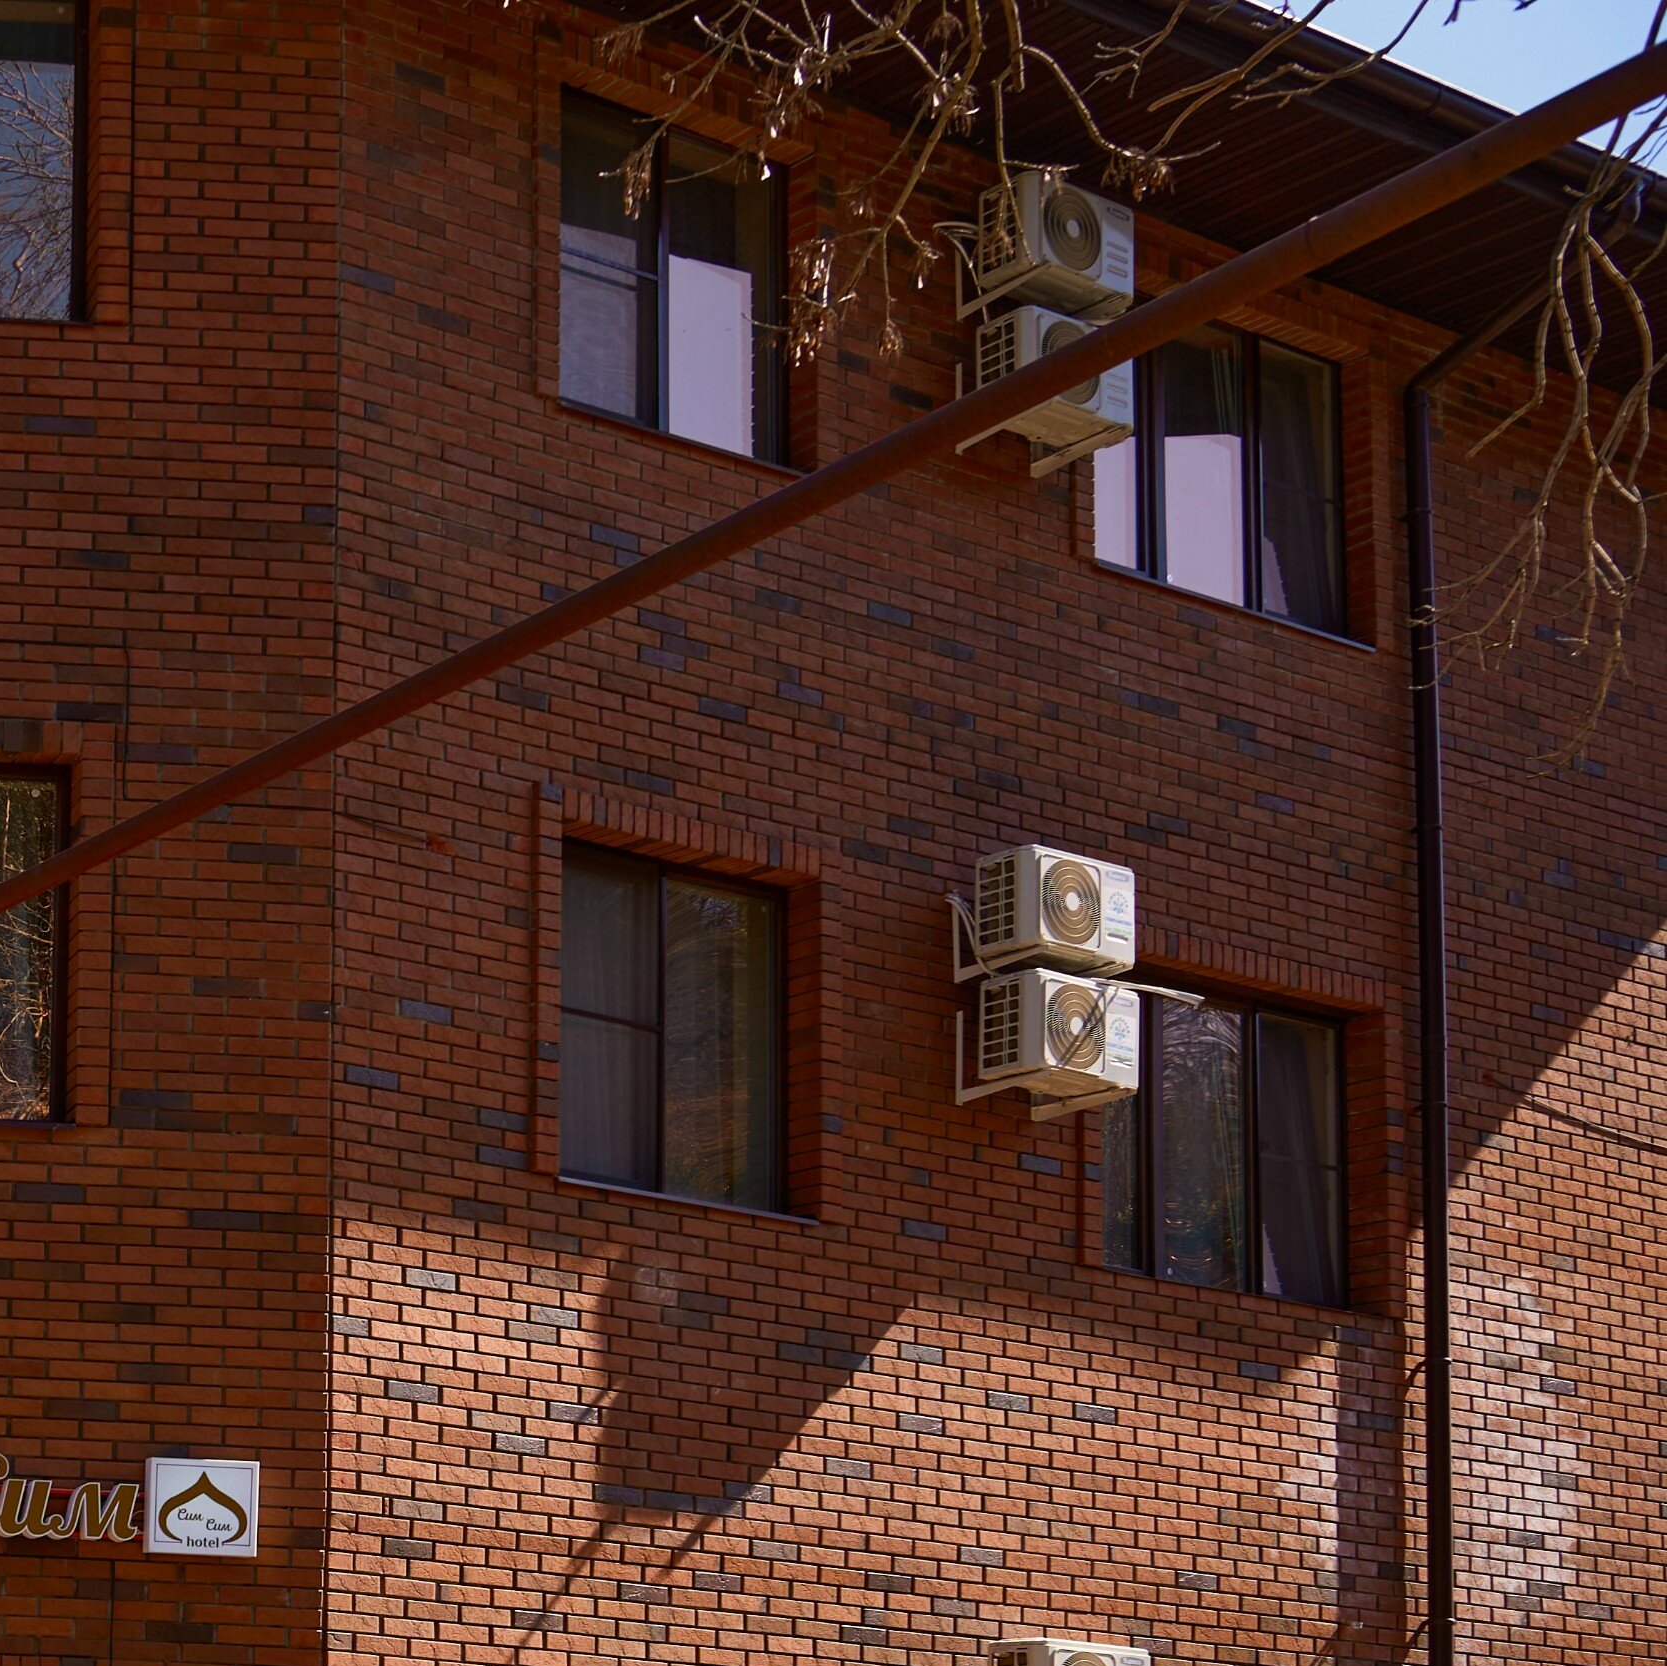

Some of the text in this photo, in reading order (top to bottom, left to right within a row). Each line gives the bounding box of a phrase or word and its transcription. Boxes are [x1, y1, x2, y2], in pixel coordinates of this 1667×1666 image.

[177, 1508, 203, 1521] Сим
[206, 1518, 232, 1531] Сим
[186, 1536, 219, 1548] hotel
